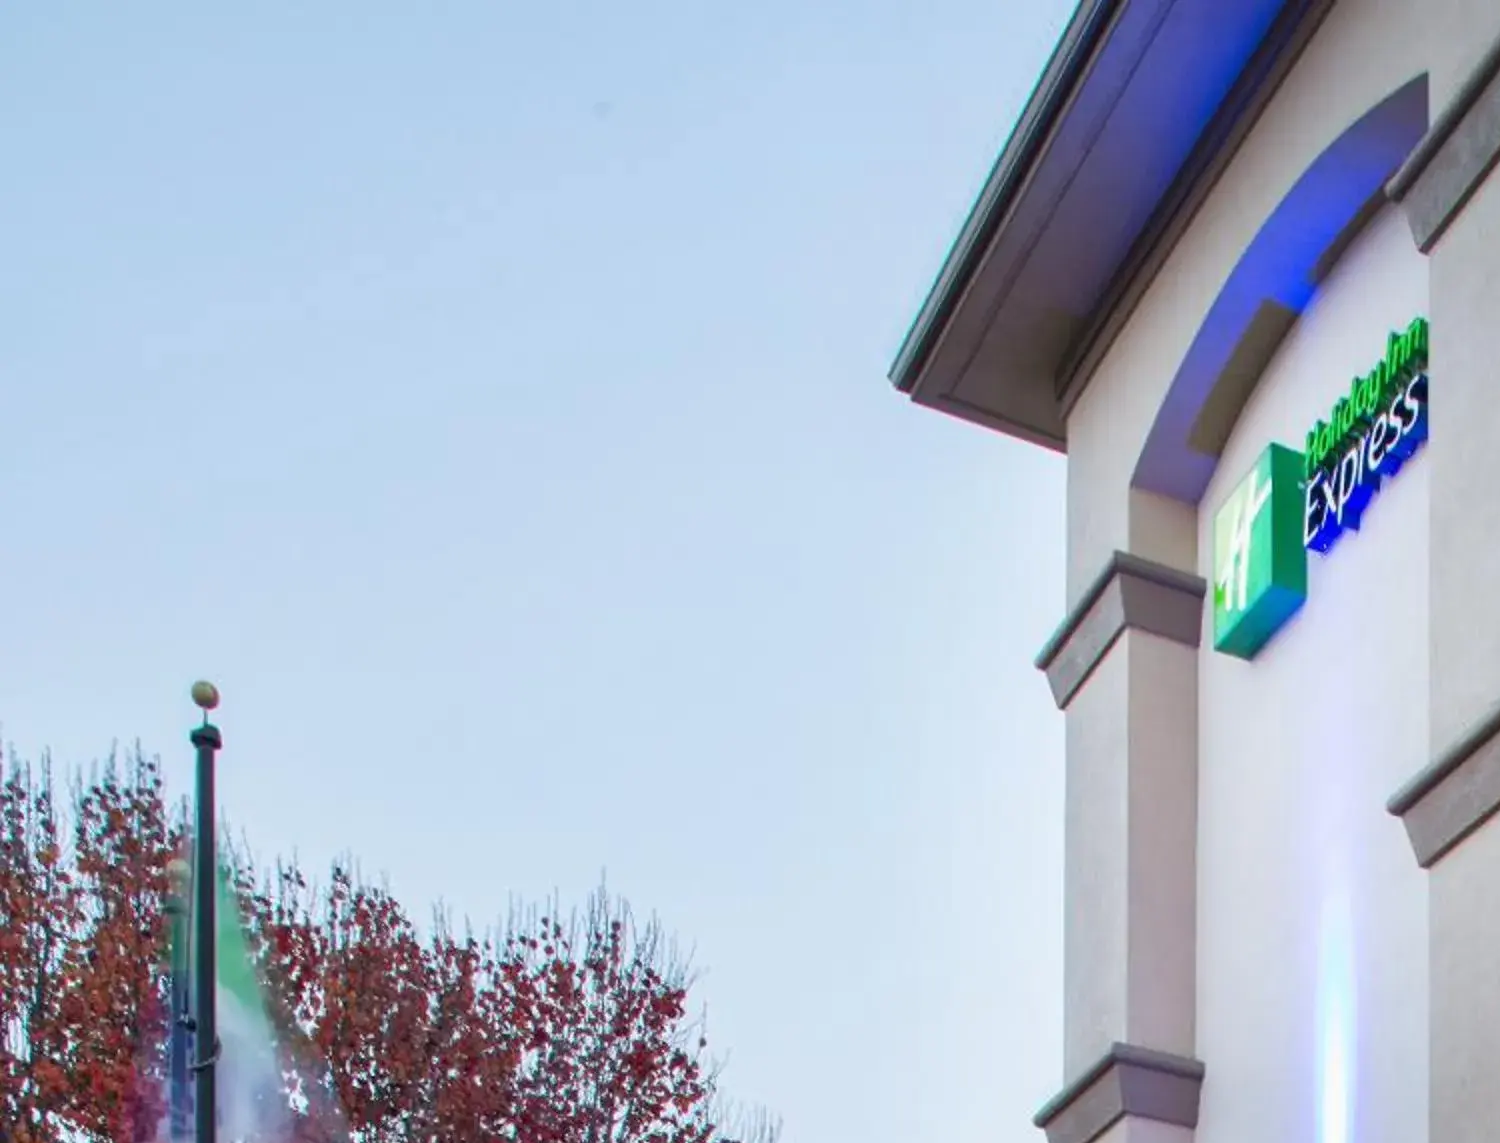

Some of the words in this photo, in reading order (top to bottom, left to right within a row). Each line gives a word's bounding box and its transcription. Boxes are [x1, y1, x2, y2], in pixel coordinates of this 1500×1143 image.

[1303, 373, 1422, 548] Express
[1305, 361, 1382, 479] Holiday
[1386, 317, 1424, 384] Inn
